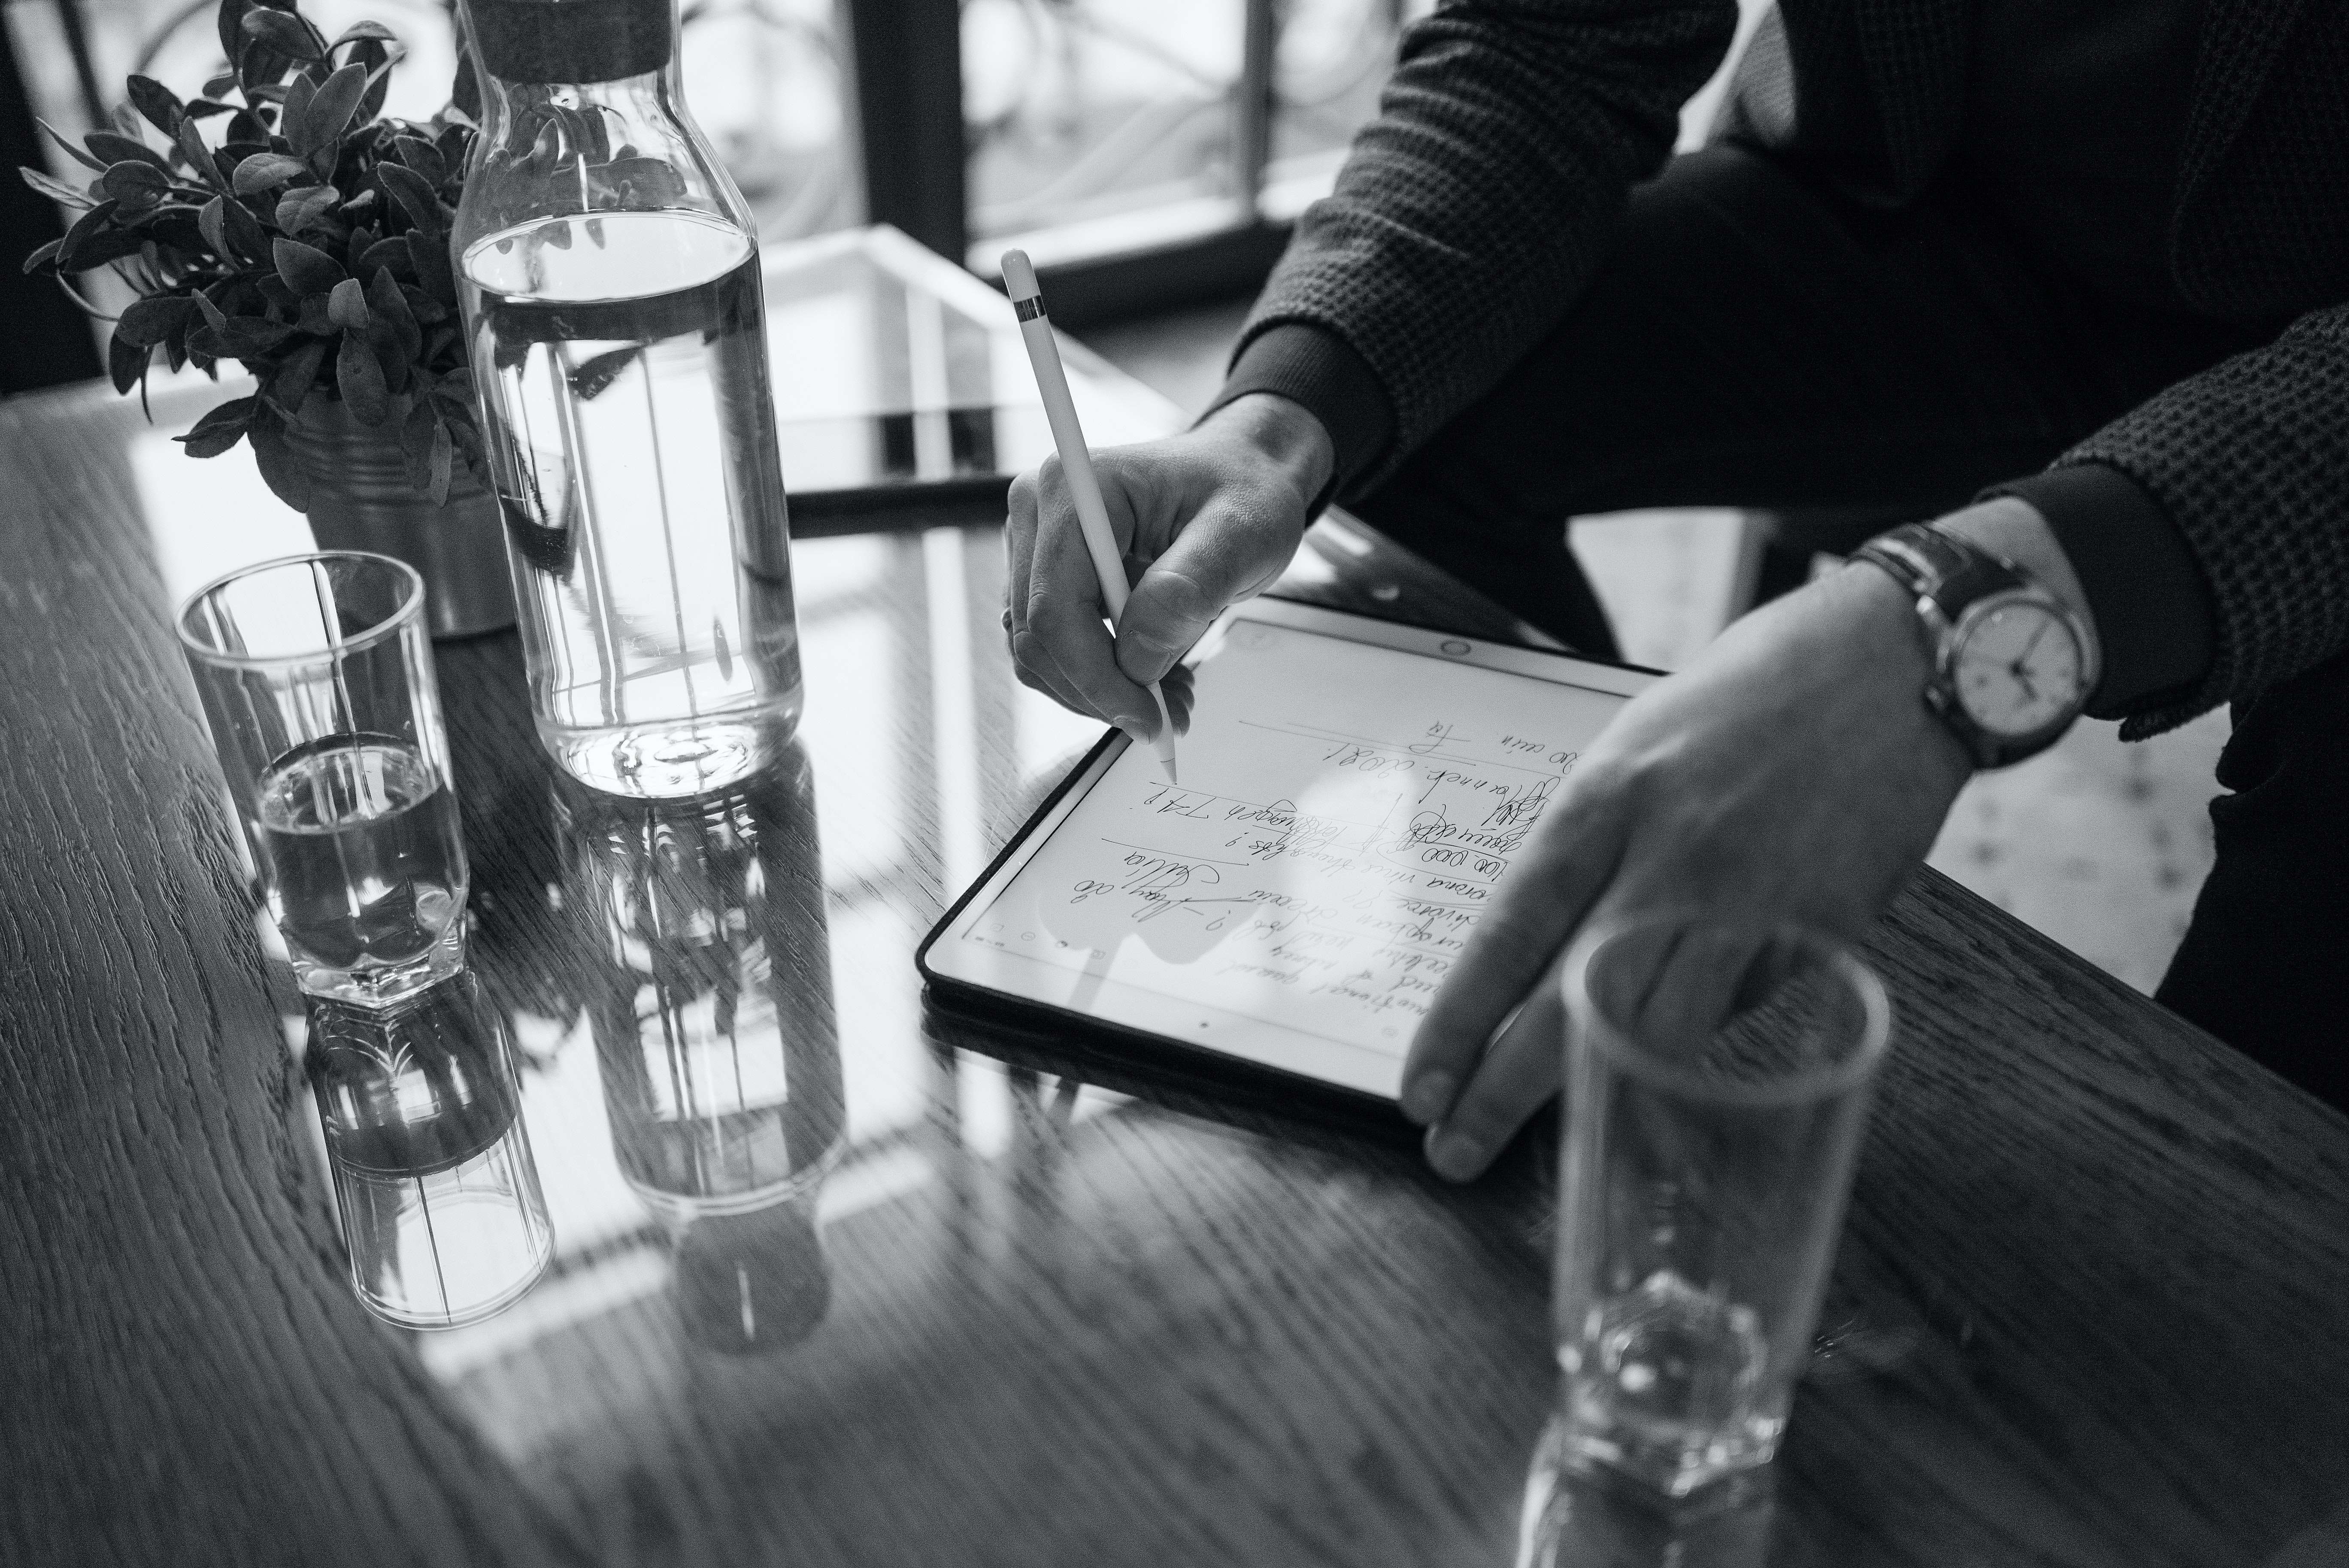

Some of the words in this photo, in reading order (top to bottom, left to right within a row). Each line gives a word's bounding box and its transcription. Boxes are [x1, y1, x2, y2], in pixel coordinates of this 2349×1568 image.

[1426, 878, 1493, 902] orona
[1356, 917, 1463, 950] uropean
[1309, 984, 1428, 1016] motional
